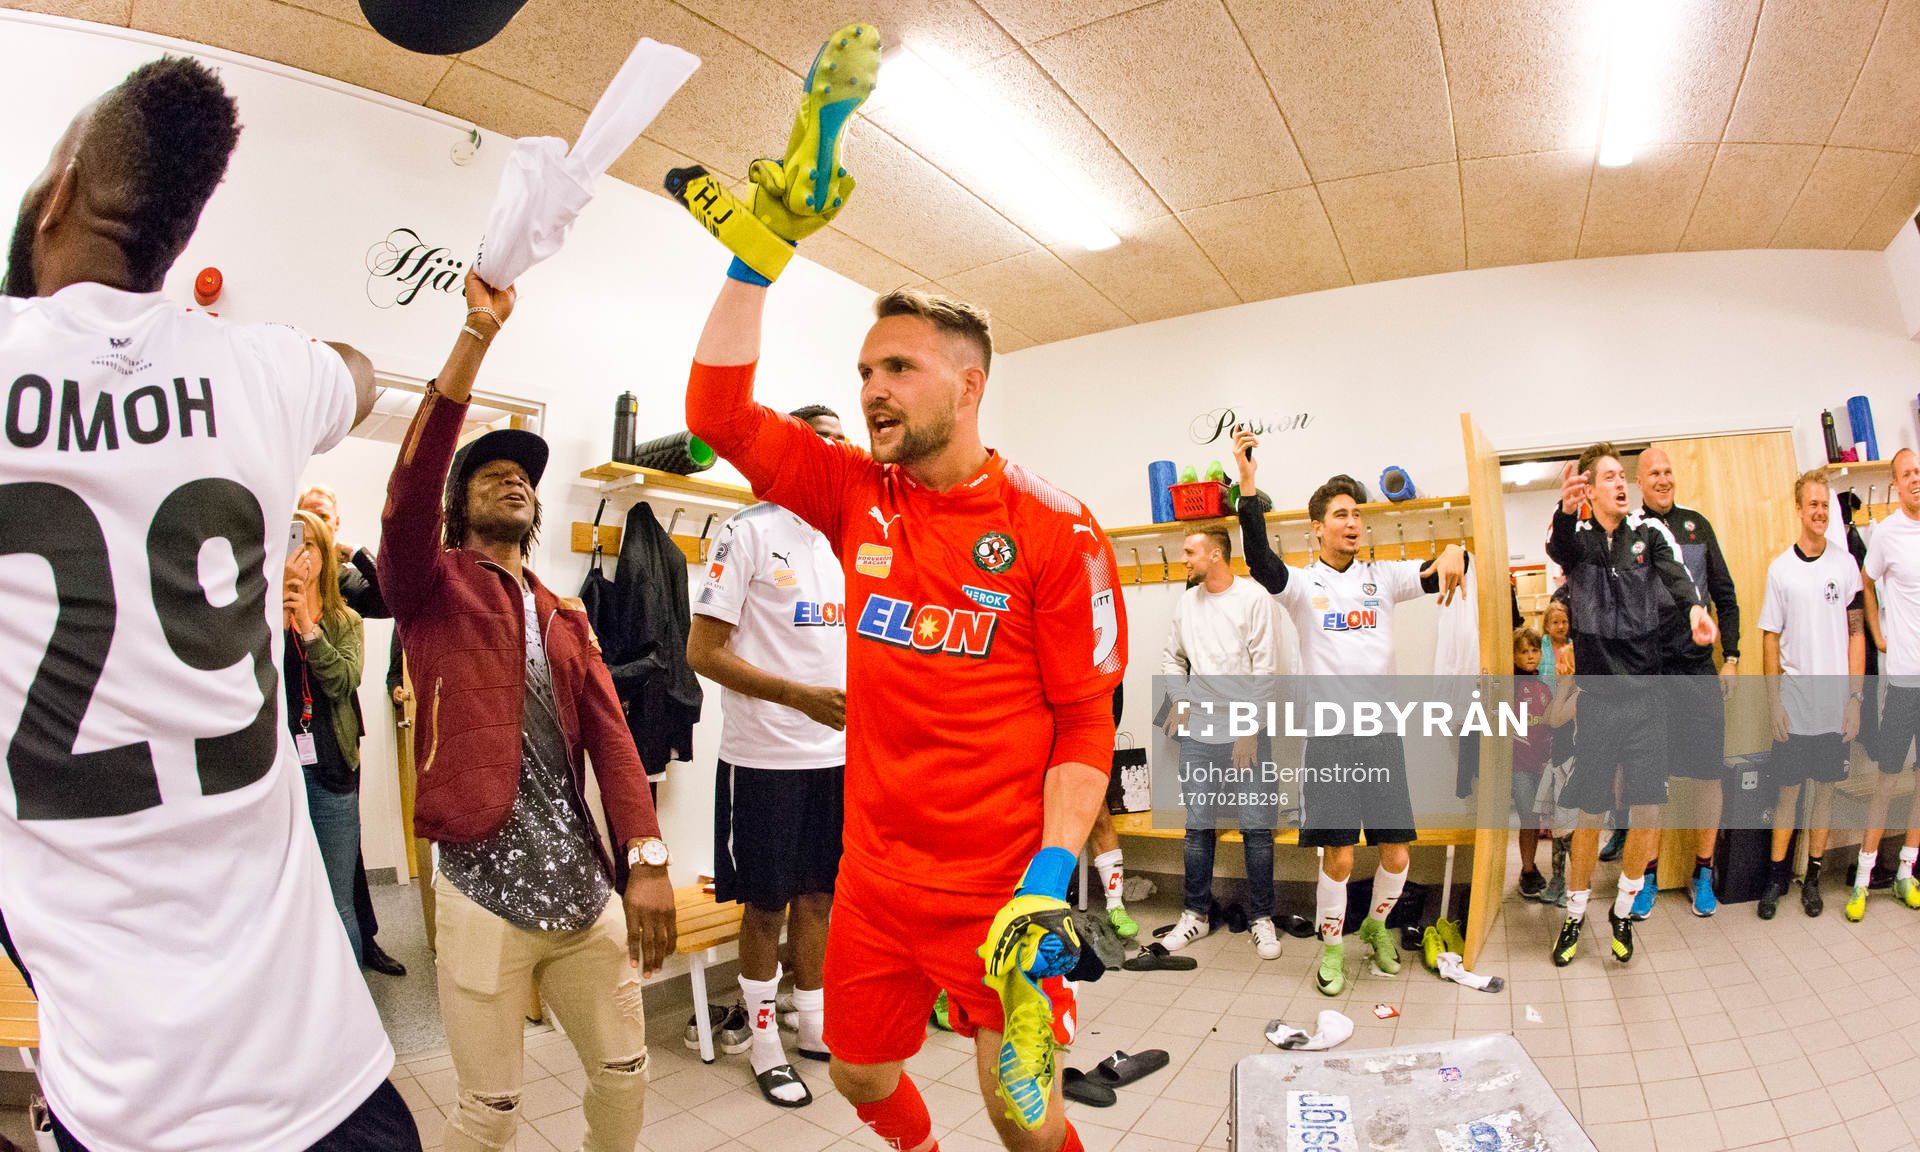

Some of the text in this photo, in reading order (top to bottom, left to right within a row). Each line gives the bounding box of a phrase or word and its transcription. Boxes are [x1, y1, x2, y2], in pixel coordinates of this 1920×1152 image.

[694, 186, 733, 224] H.J
[366, 228, 467, 308] Hjä
[5, 373, 217, 452] OMOH
[0, 478, 278, 820] 29
[856, 593, 999, 659] ELON
[1322, 610, 1377, 631] ELON
